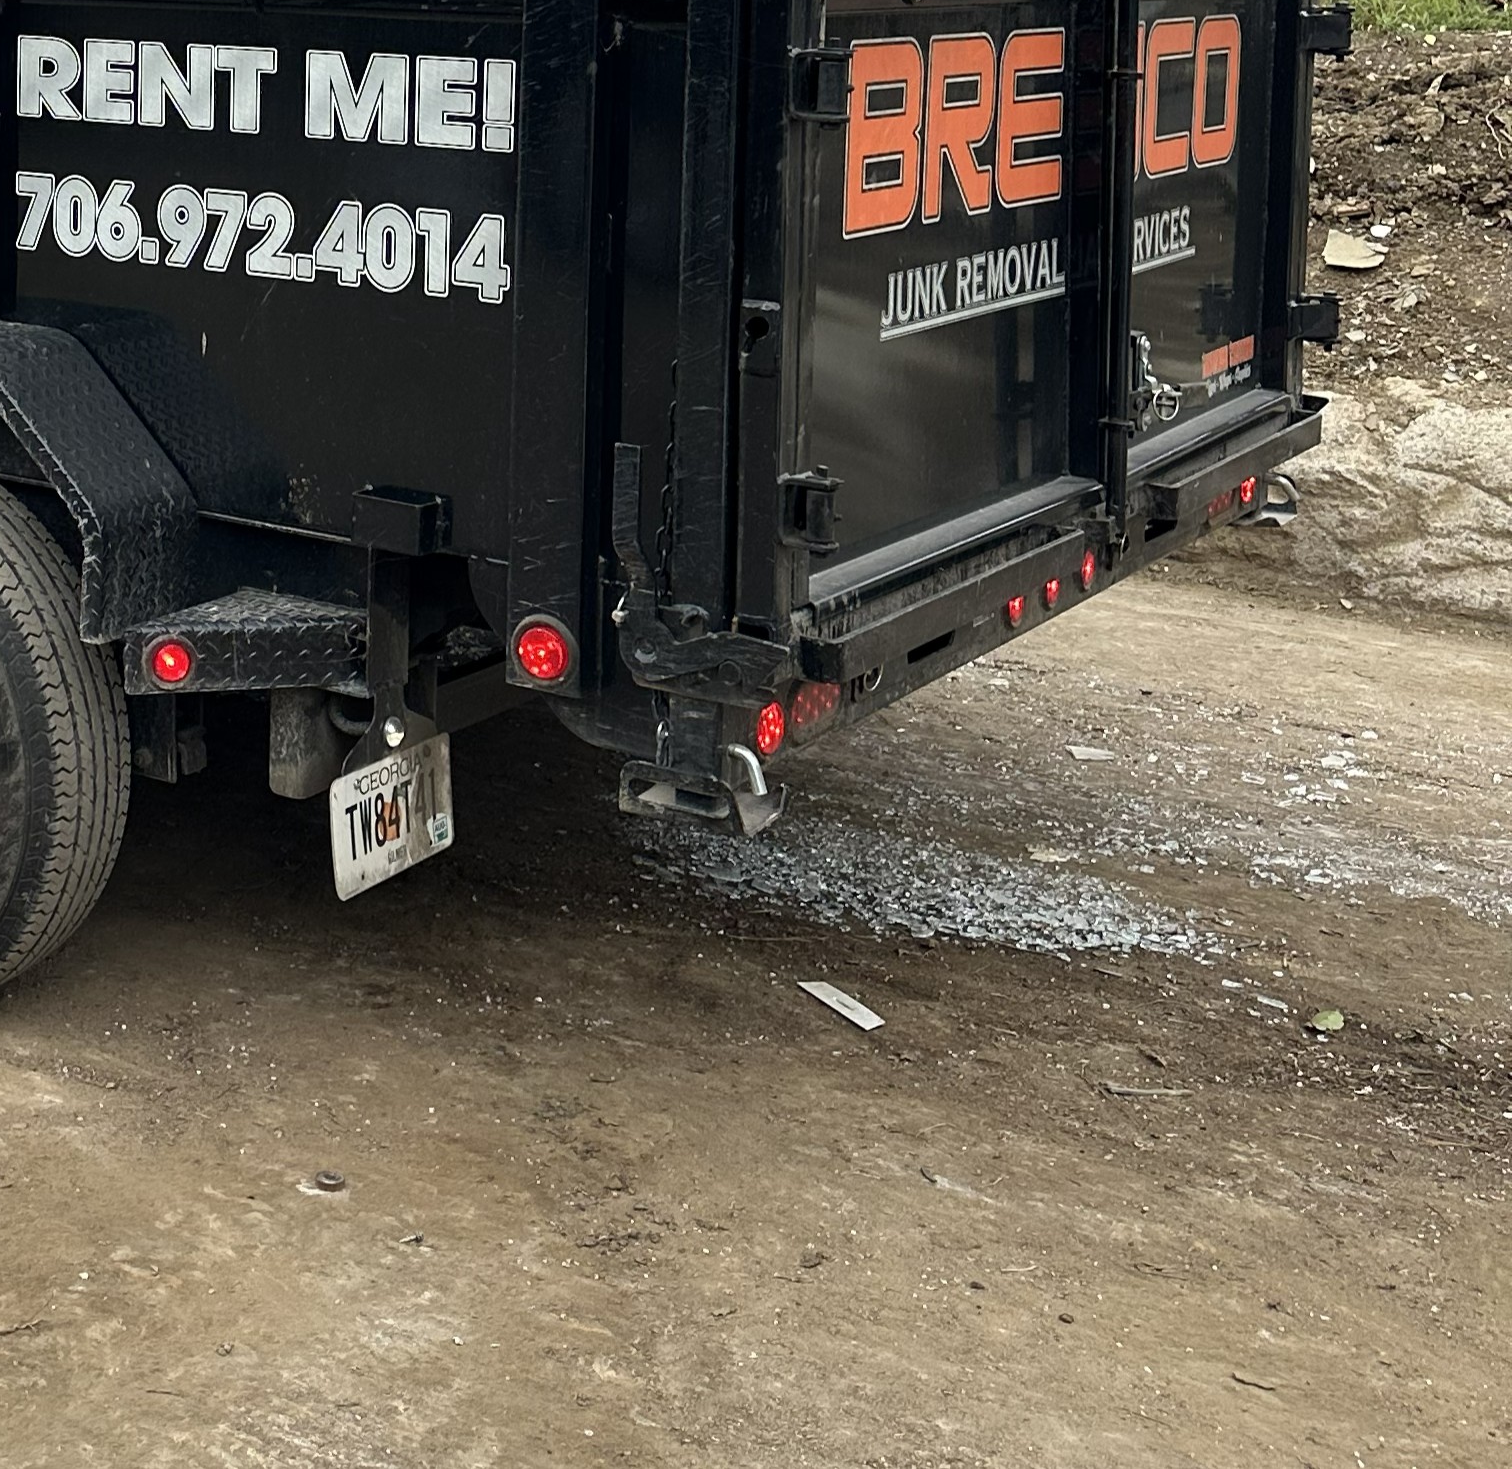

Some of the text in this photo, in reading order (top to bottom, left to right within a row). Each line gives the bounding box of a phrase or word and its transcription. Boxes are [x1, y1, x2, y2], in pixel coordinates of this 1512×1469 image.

[17, 35, 516, 153] RENT ME!
[843, 14, 1241, 240] BRECO
[16, 172, 510, 304] 706.972.4014
[880, 205, 1190, 328] JUNK REMOVAL RVICES
[359, 754, 423, 795] GEORGIA
